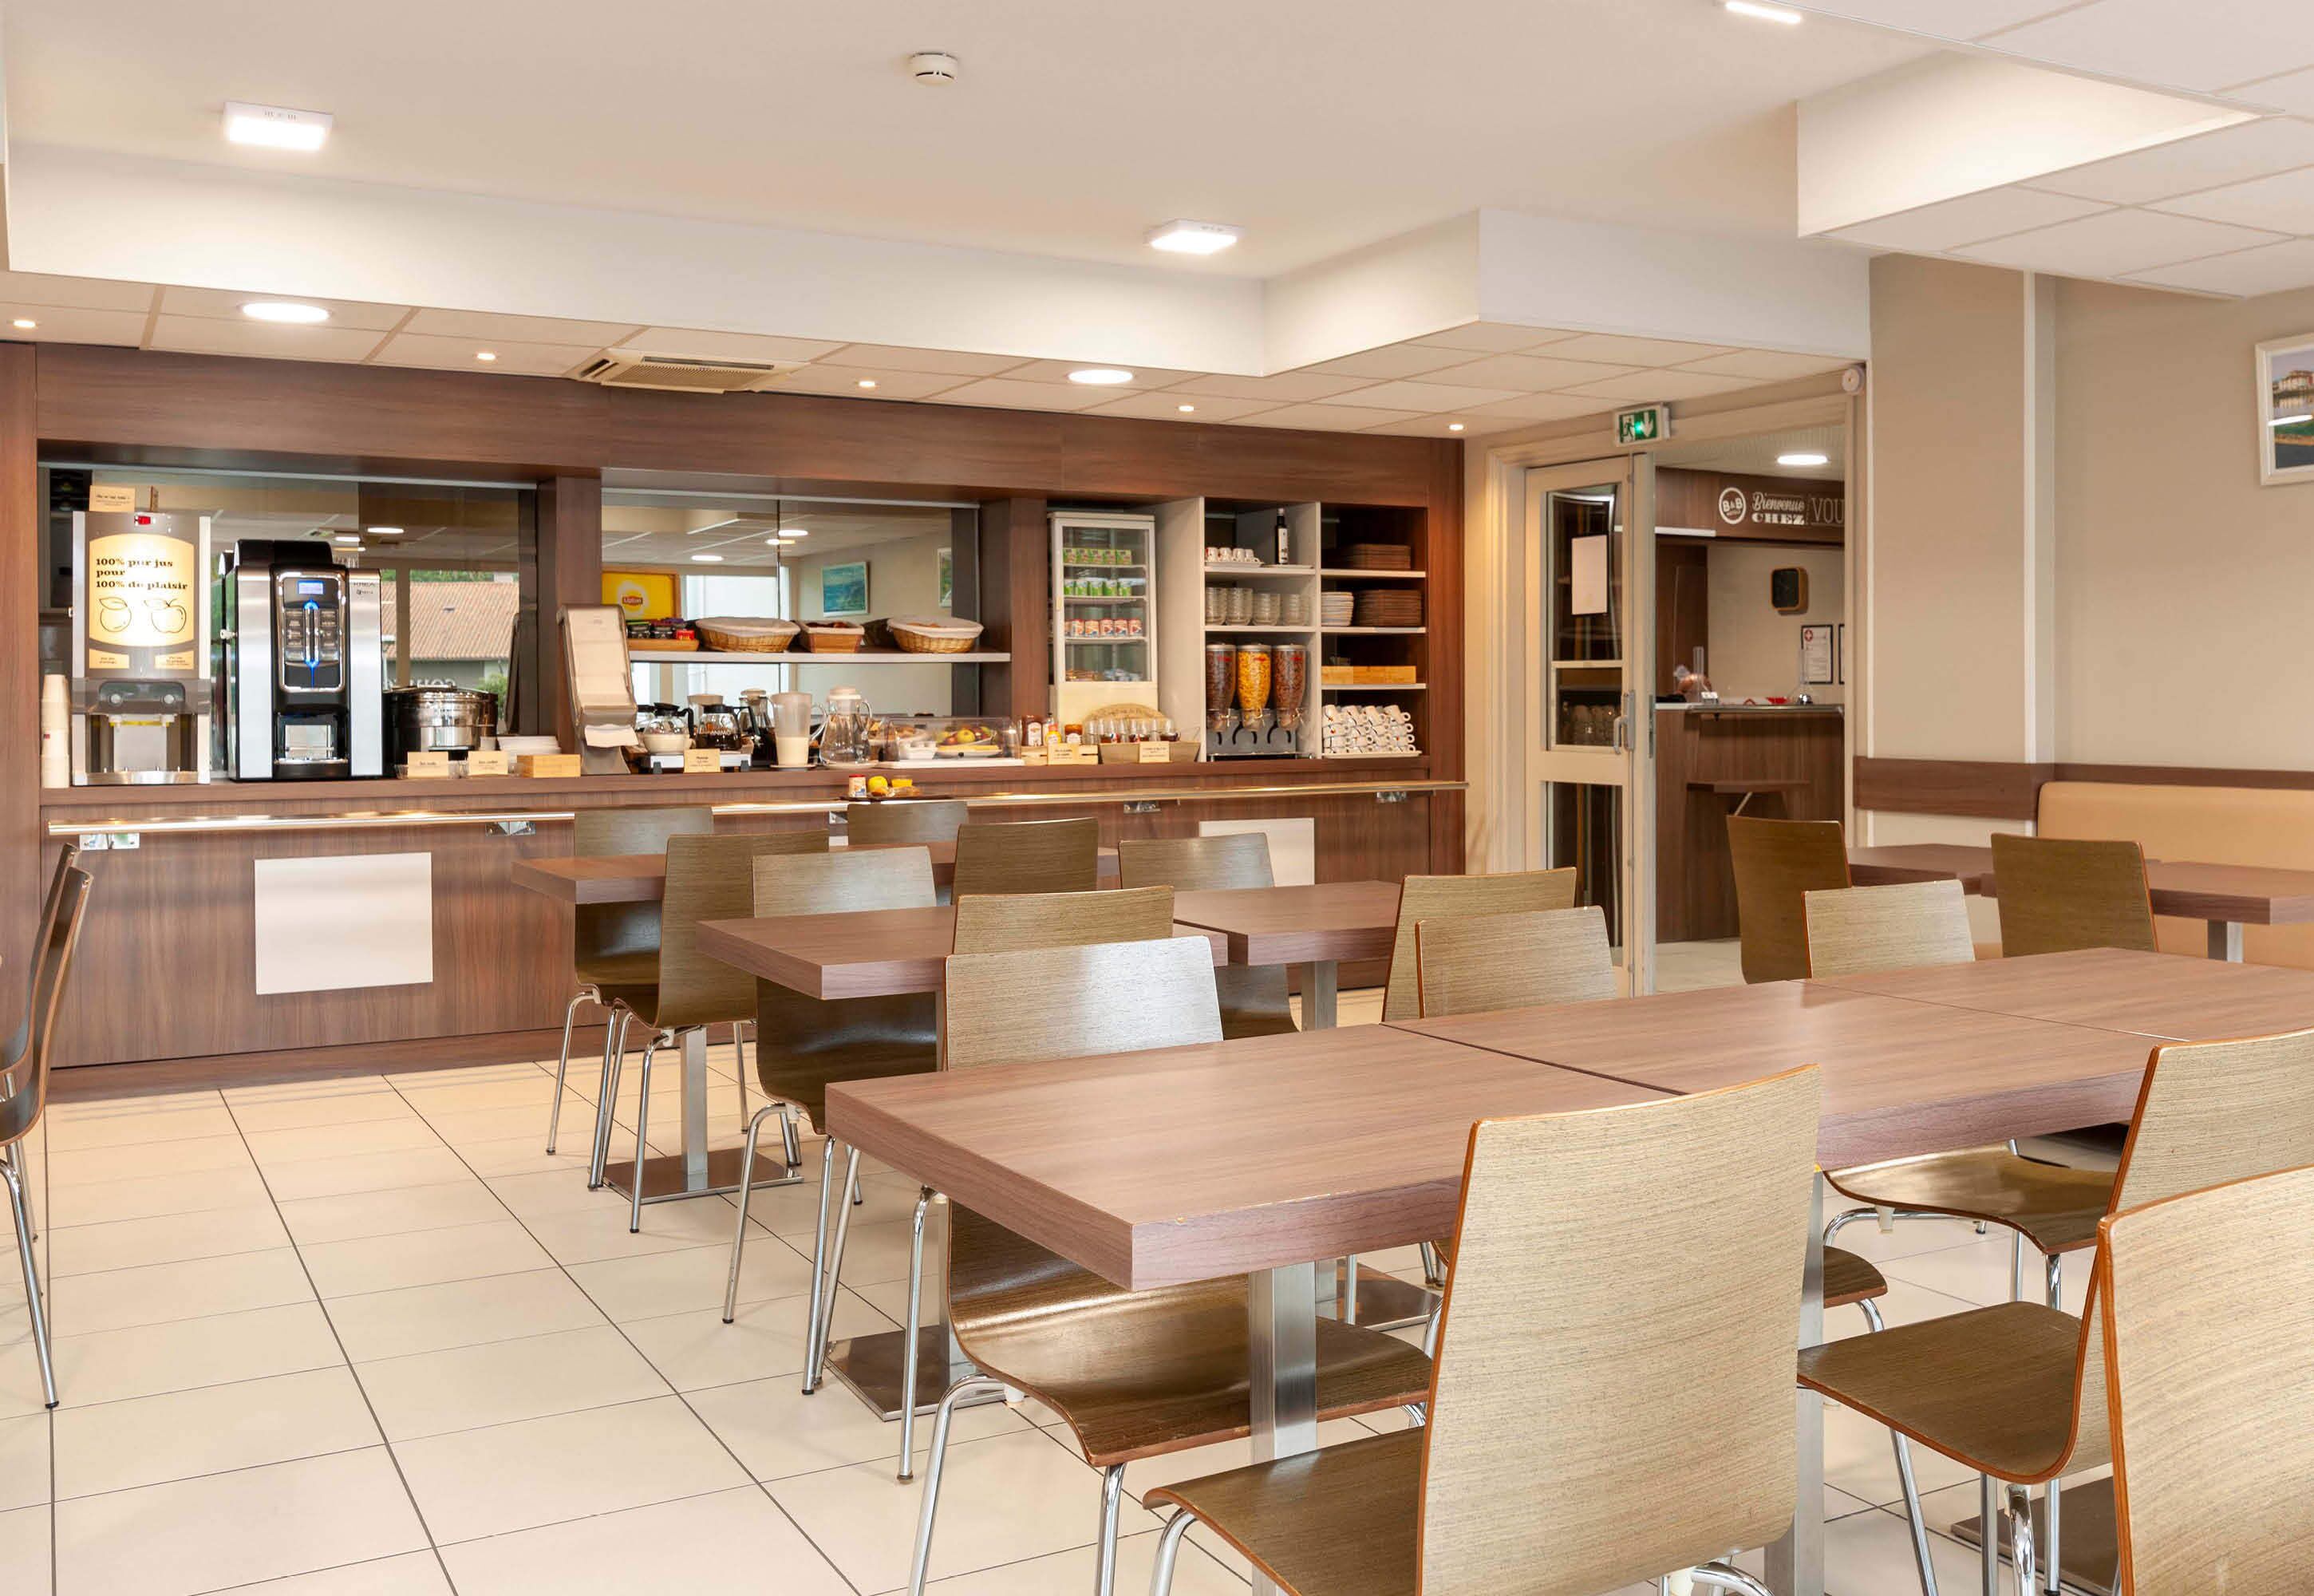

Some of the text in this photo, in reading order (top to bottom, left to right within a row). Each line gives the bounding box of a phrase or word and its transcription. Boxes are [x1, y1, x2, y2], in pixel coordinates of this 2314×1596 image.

[1722, 497, 1743, 512] B&B
[1752, 492, 1805, 512] Bienvenue
[1751, 512, 1805, 525] CHEZ
[155, 559, 173, 568] jus
[147, 582, 188, 591] plaisir
